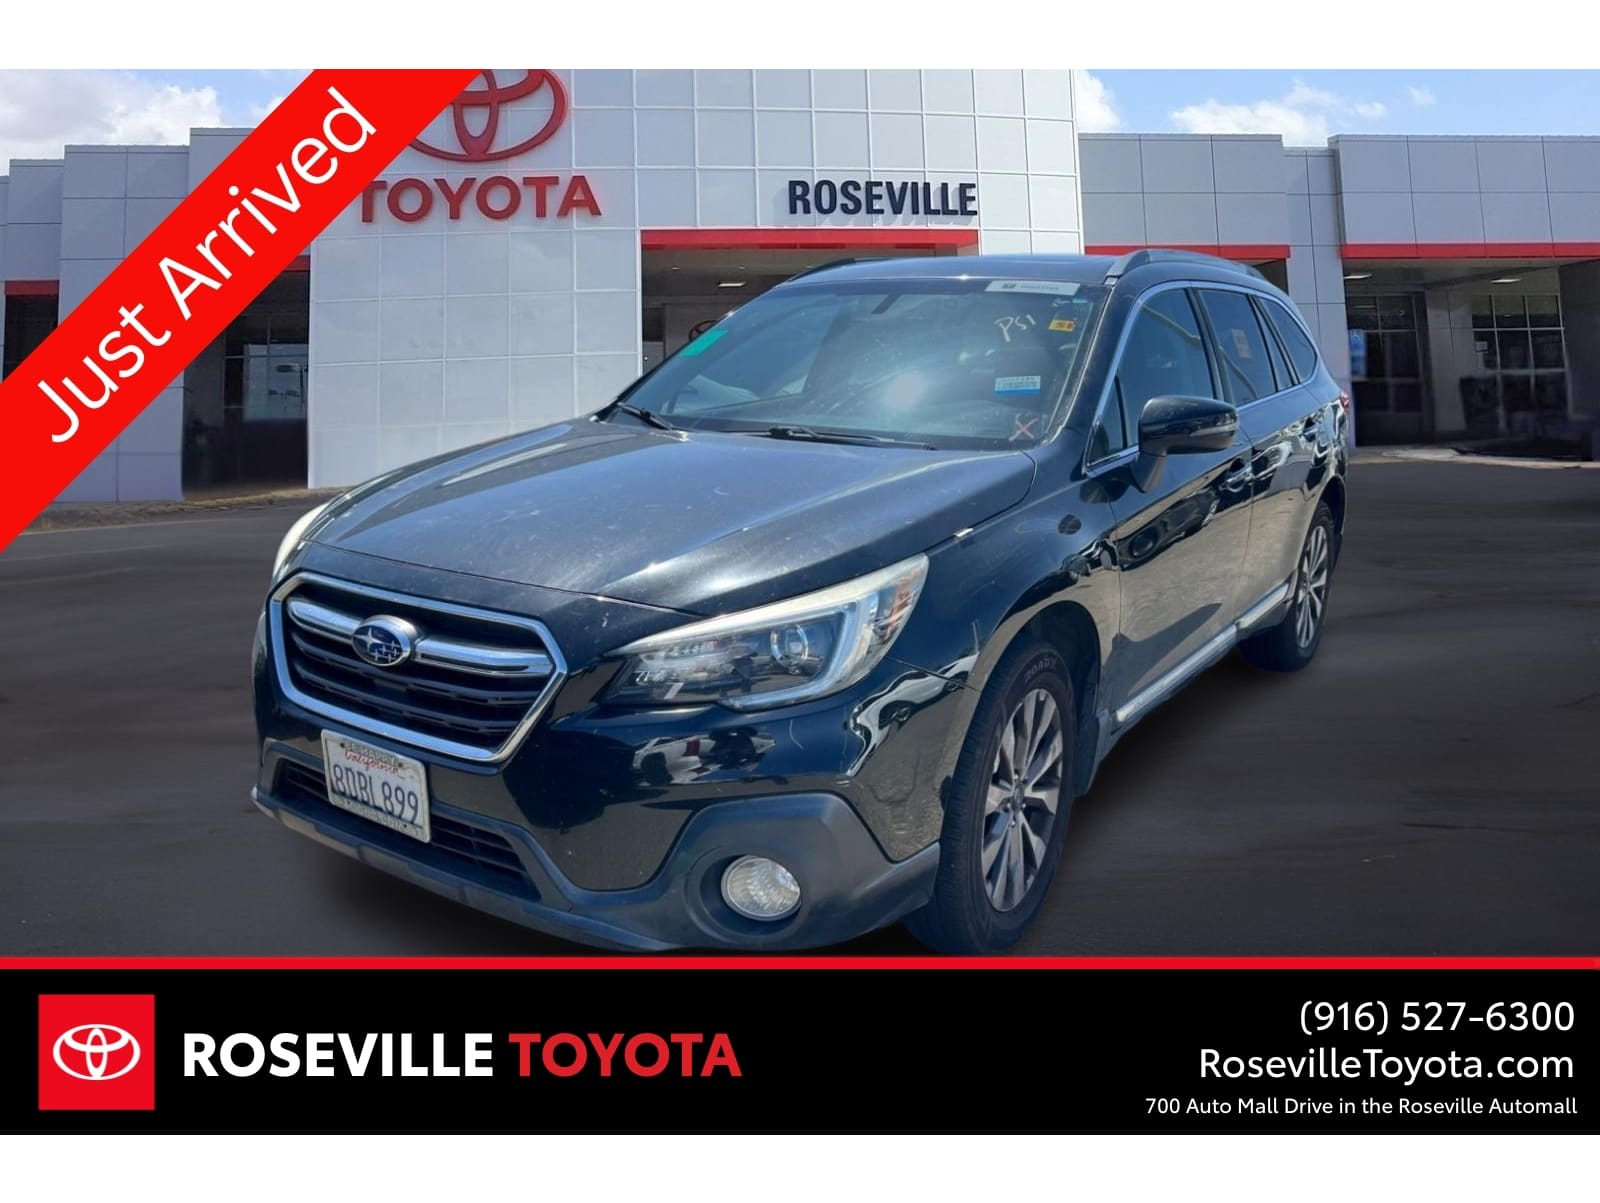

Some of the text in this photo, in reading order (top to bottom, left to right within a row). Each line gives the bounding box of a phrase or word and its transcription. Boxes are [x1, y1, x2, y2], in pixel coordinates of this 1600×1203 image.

[360, 175, 602, 223] TOYOTA
[788, 180, 978, 216] ROSEVILLE
[333, 763, 419, 826] 8DBL899
